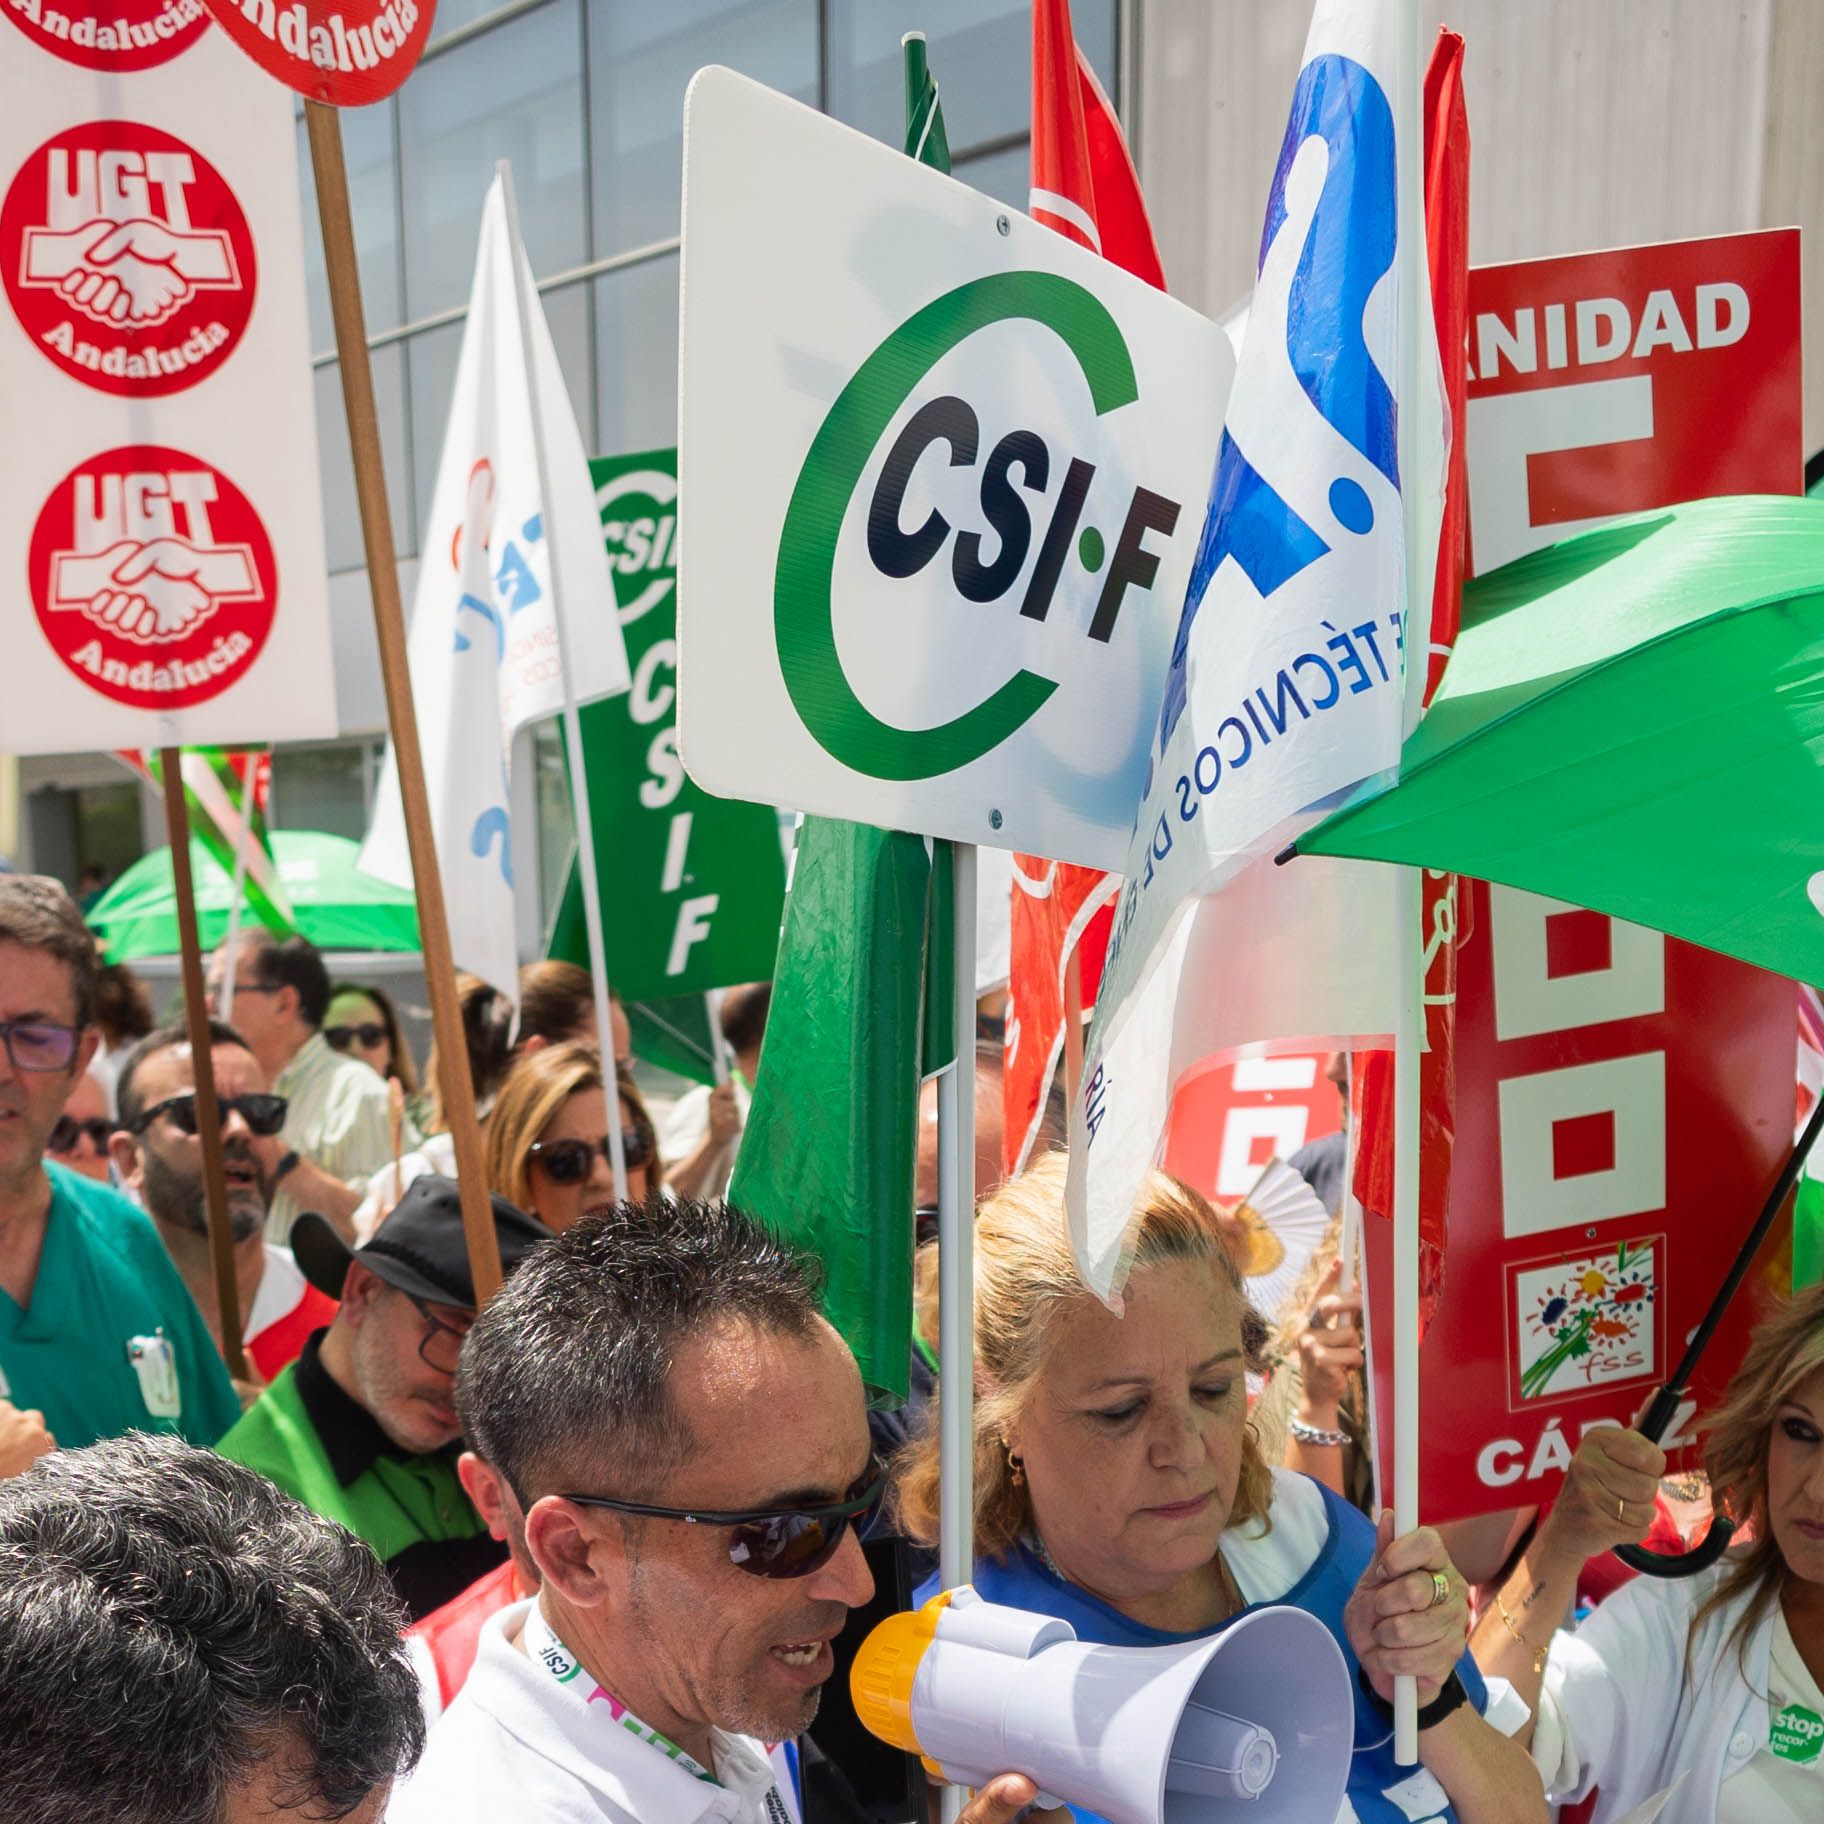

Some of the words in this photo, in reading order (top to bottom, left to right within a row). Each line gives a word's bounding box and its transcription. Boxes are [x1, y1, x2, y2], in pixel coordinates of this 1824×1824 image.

[48, 148, 195, 229] UGT
[73, 469, 218, 551] UGT
[603, 515, 678, 575] CSI
[1775, 1712, 1824, 1740] stop
